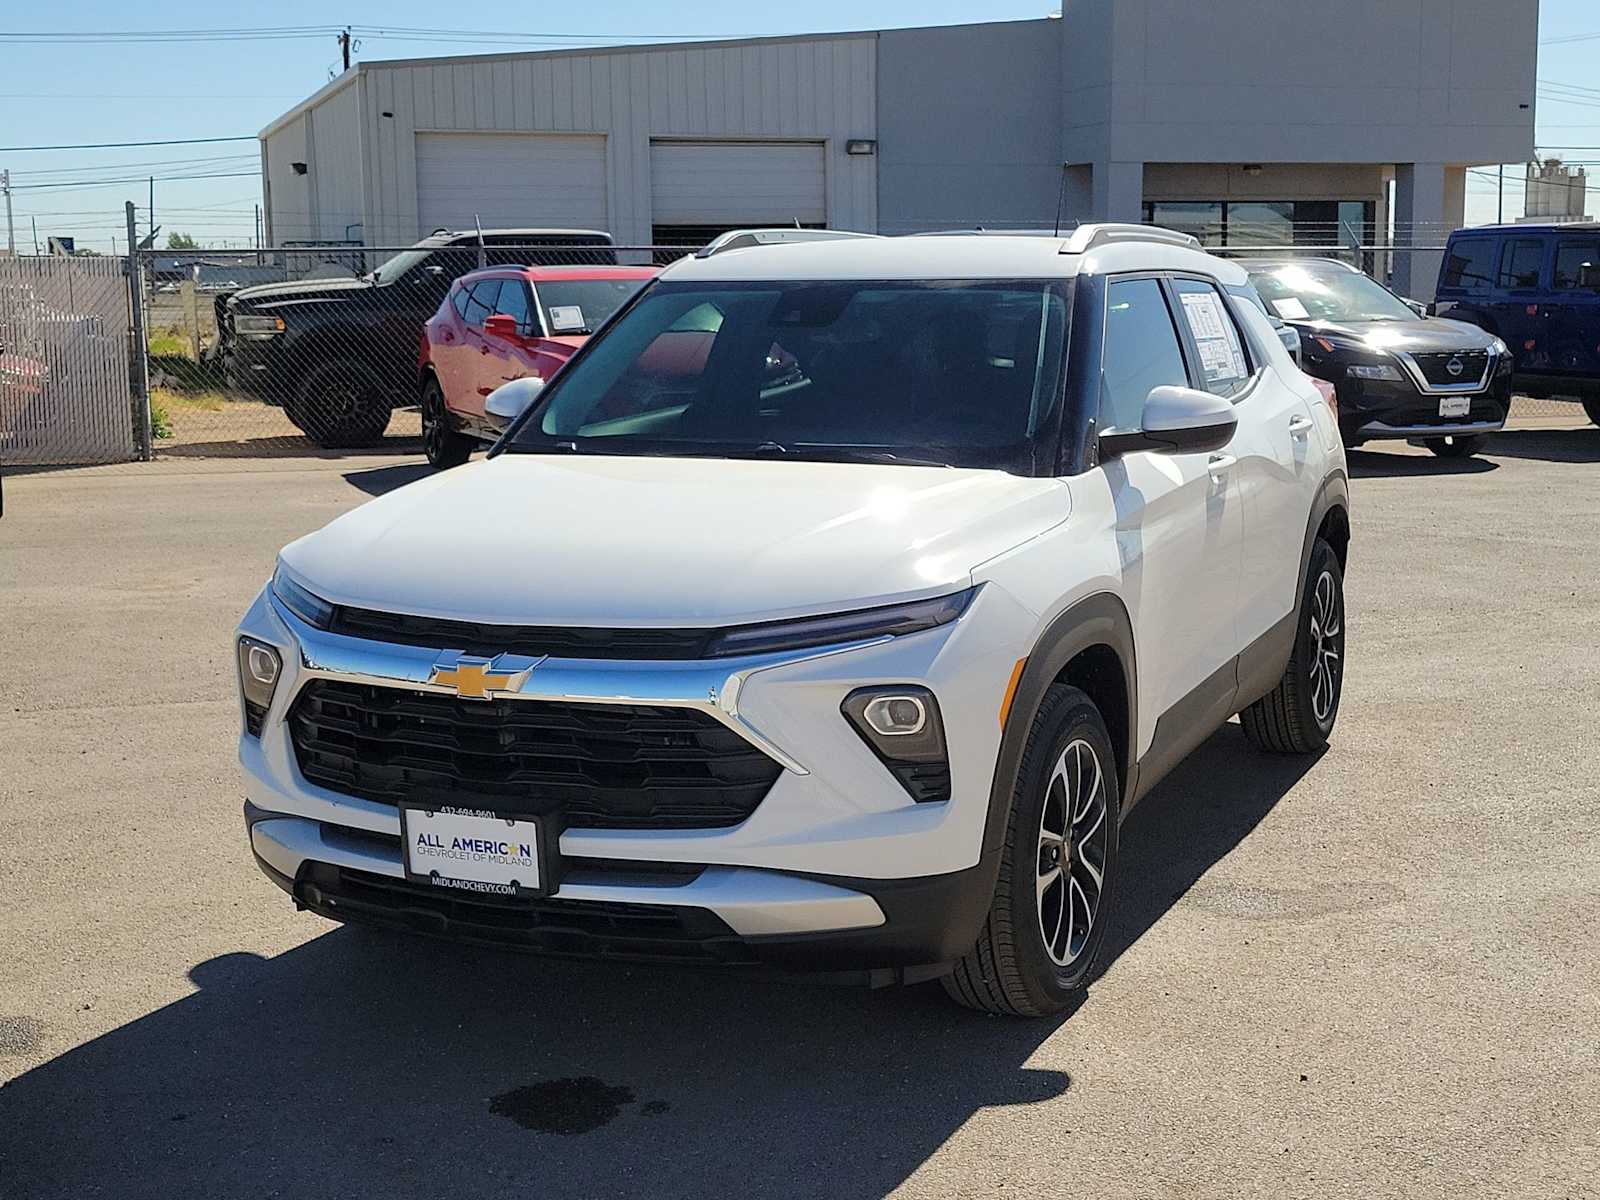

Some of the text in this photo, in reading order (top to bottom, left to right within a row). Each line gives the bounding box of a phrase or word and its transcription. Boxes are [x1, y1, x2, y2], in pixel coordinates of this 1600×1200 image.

[417, 833, 444, 847] ALL
[417, 847, 532, 867] CHEVROLET OF MIDLAND
[432, 877, 516, 895] MIDLANDCHEVY.COM
